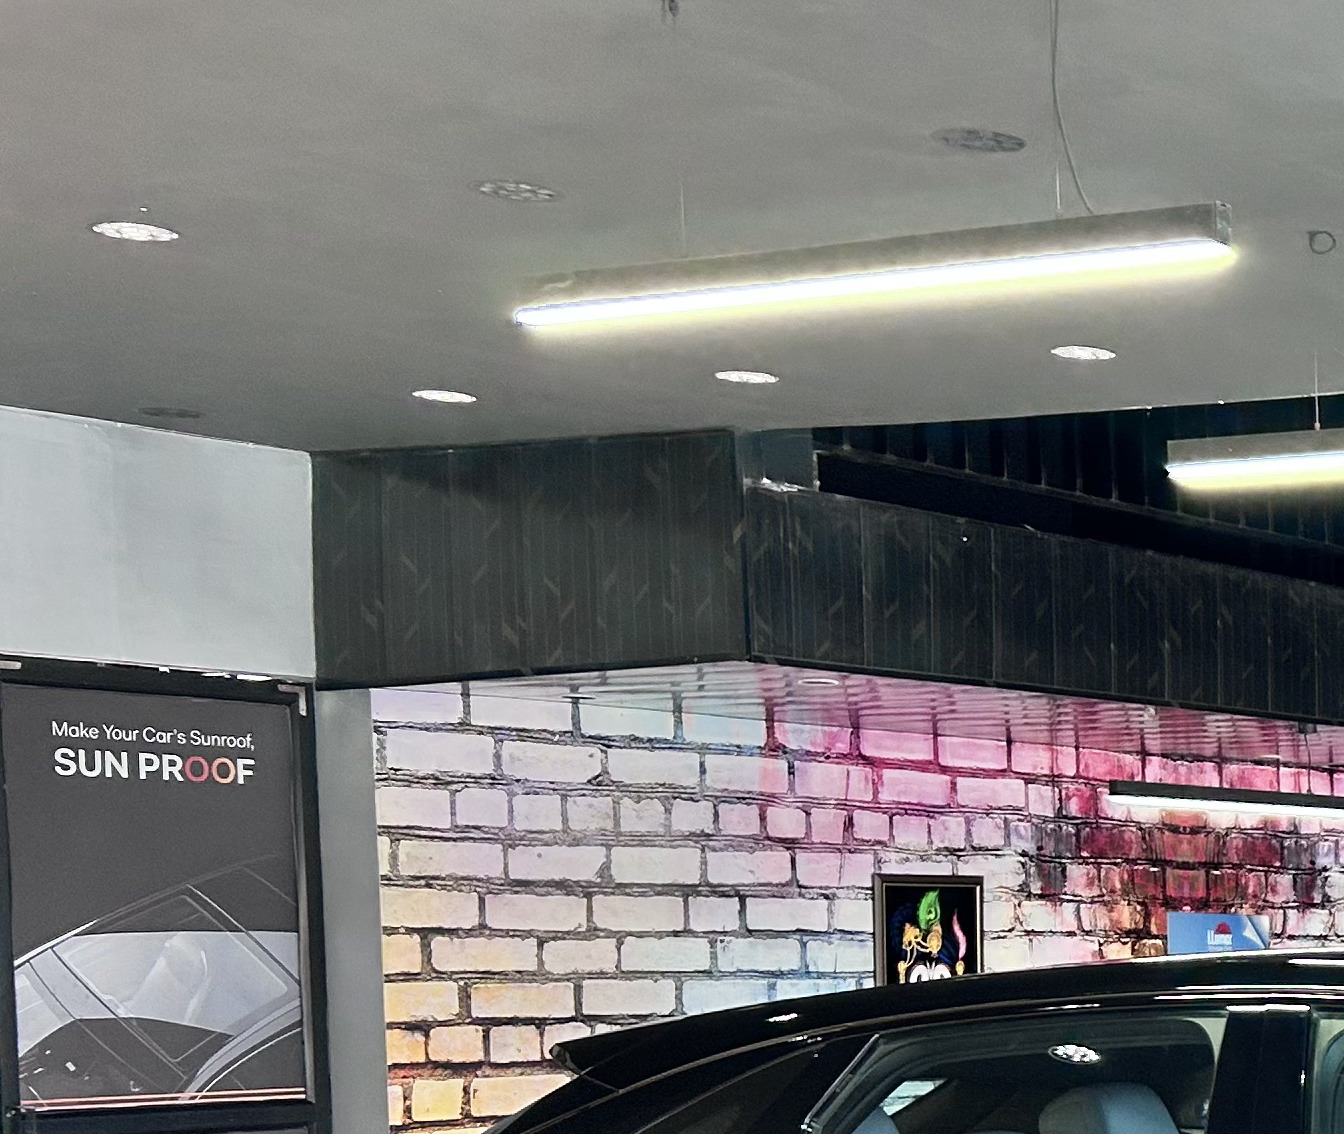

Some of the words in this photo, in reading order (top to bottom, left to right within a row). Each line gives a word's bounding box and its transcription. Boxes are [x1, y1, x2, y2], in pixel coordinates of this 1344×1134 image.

[51, 720, 100, 739] Make
[102, 724, 140, 742] Your
[142, 727, 187, 744] Car's
[190, 730, 255, 751] Sunroof,
[54, 747, 129, 779] SUN
[138, 752, 256, 784] PROOF
